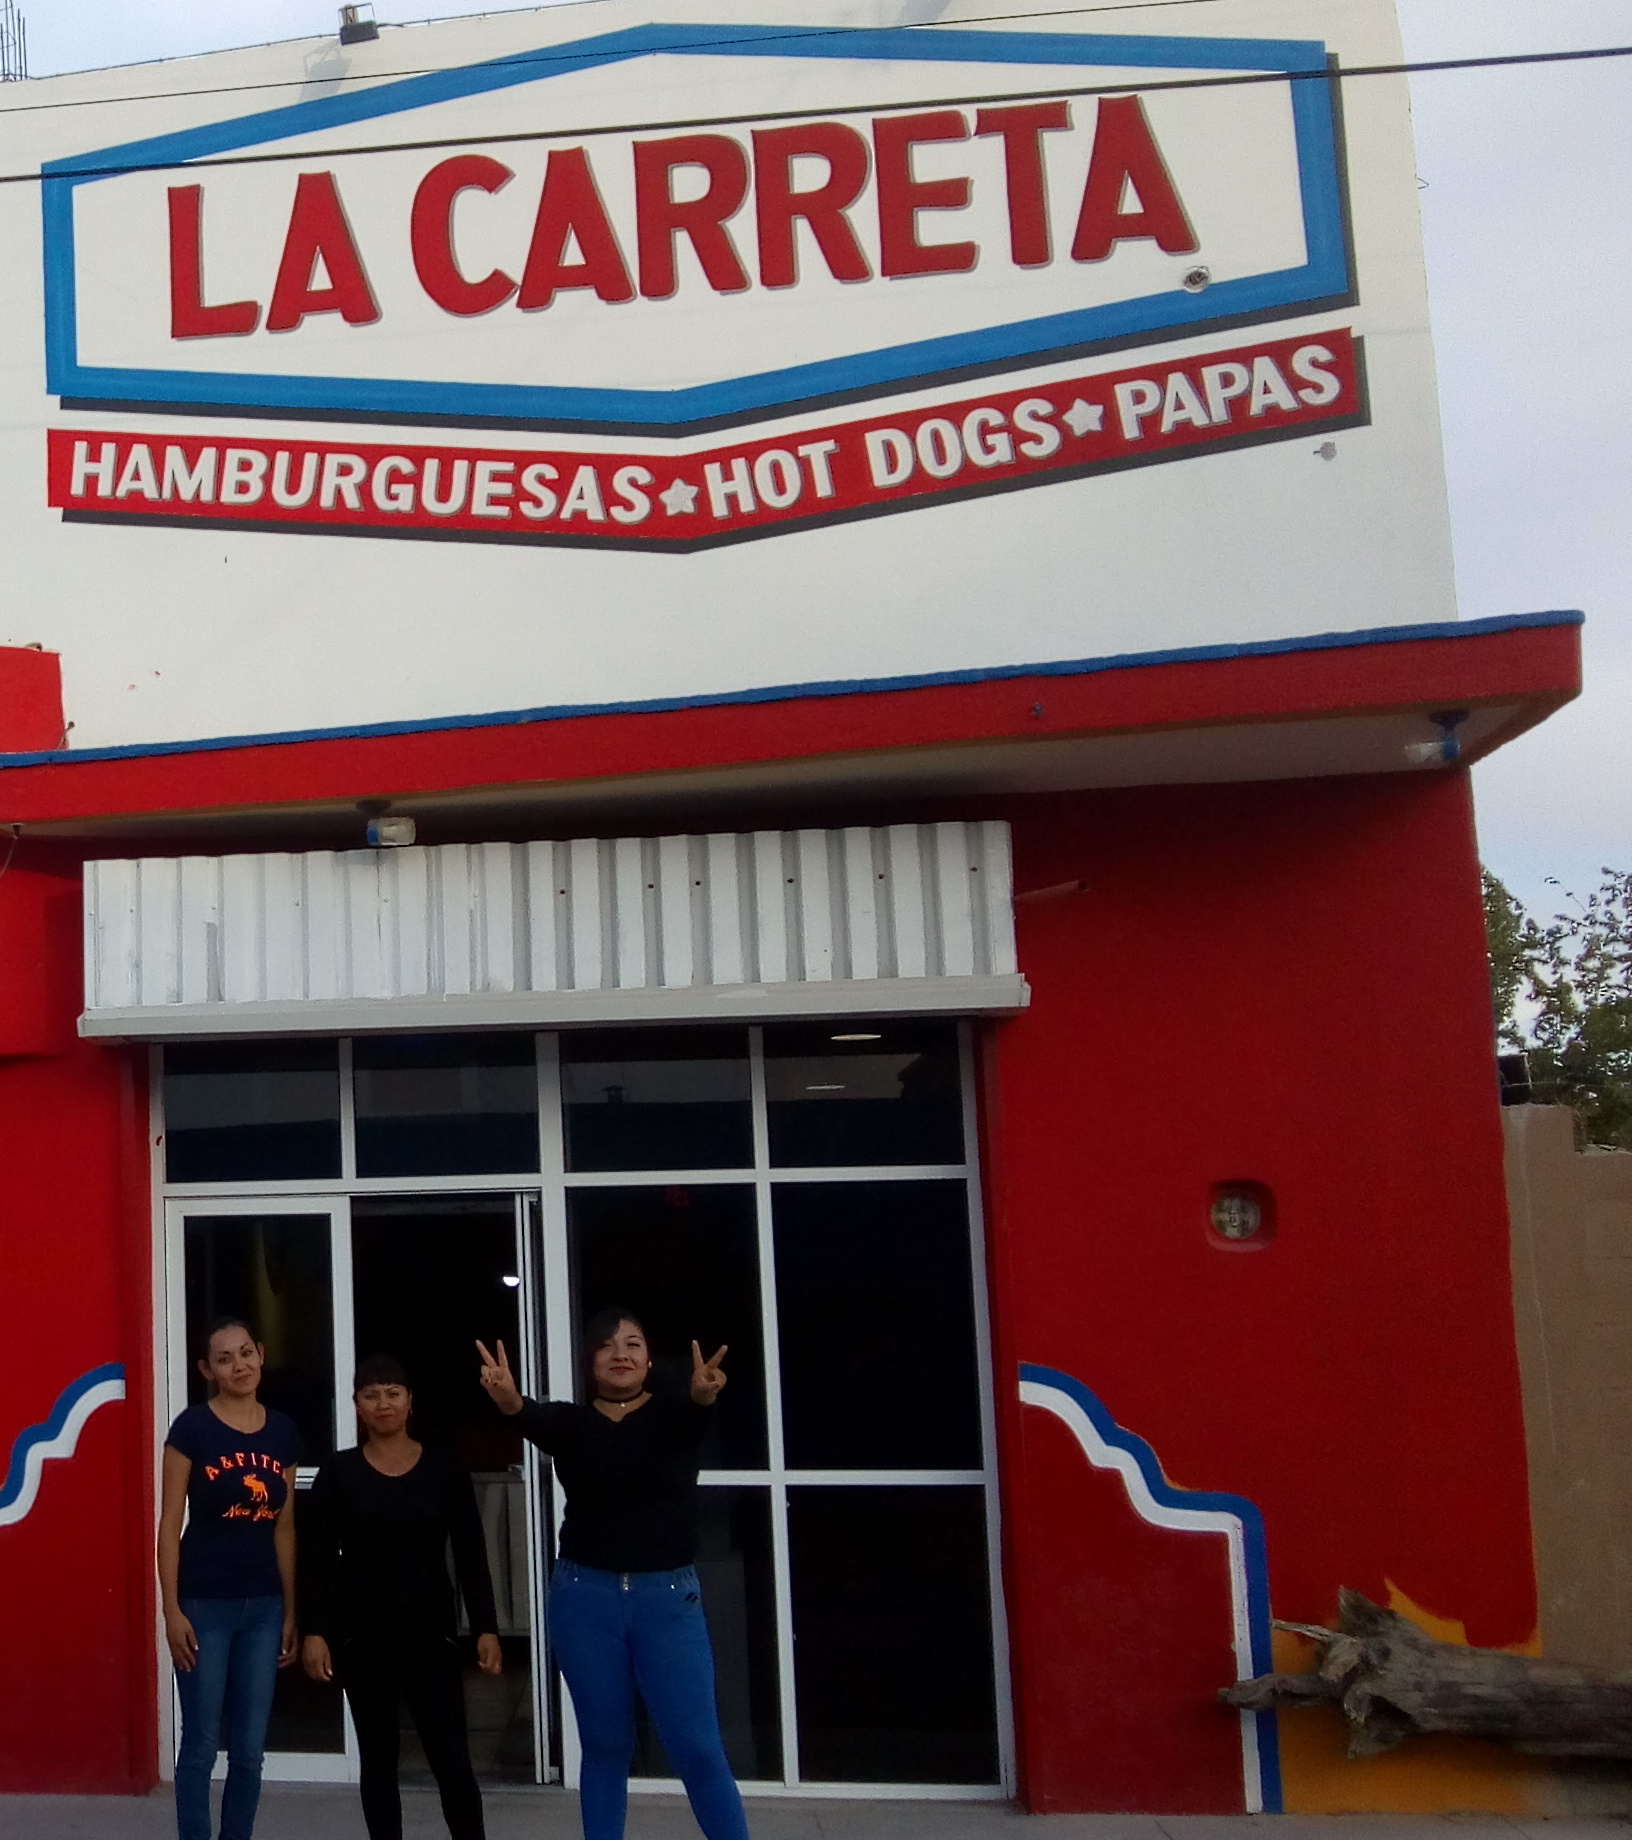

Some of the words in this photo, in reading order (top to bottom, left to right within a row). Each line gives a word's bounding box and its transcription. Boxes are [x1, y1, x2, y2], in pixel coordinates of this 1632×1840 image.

[167, 170, 381, 340] LA
[410, 94, 1200, 318] CARRETA
[69, 439, 652, 525] HAMBURGUESAS
[704, 438, 839, 520] HOT
[864, 398, 1064, 490] DOGS
[1113, 344, 1343, 442] PAPAS
